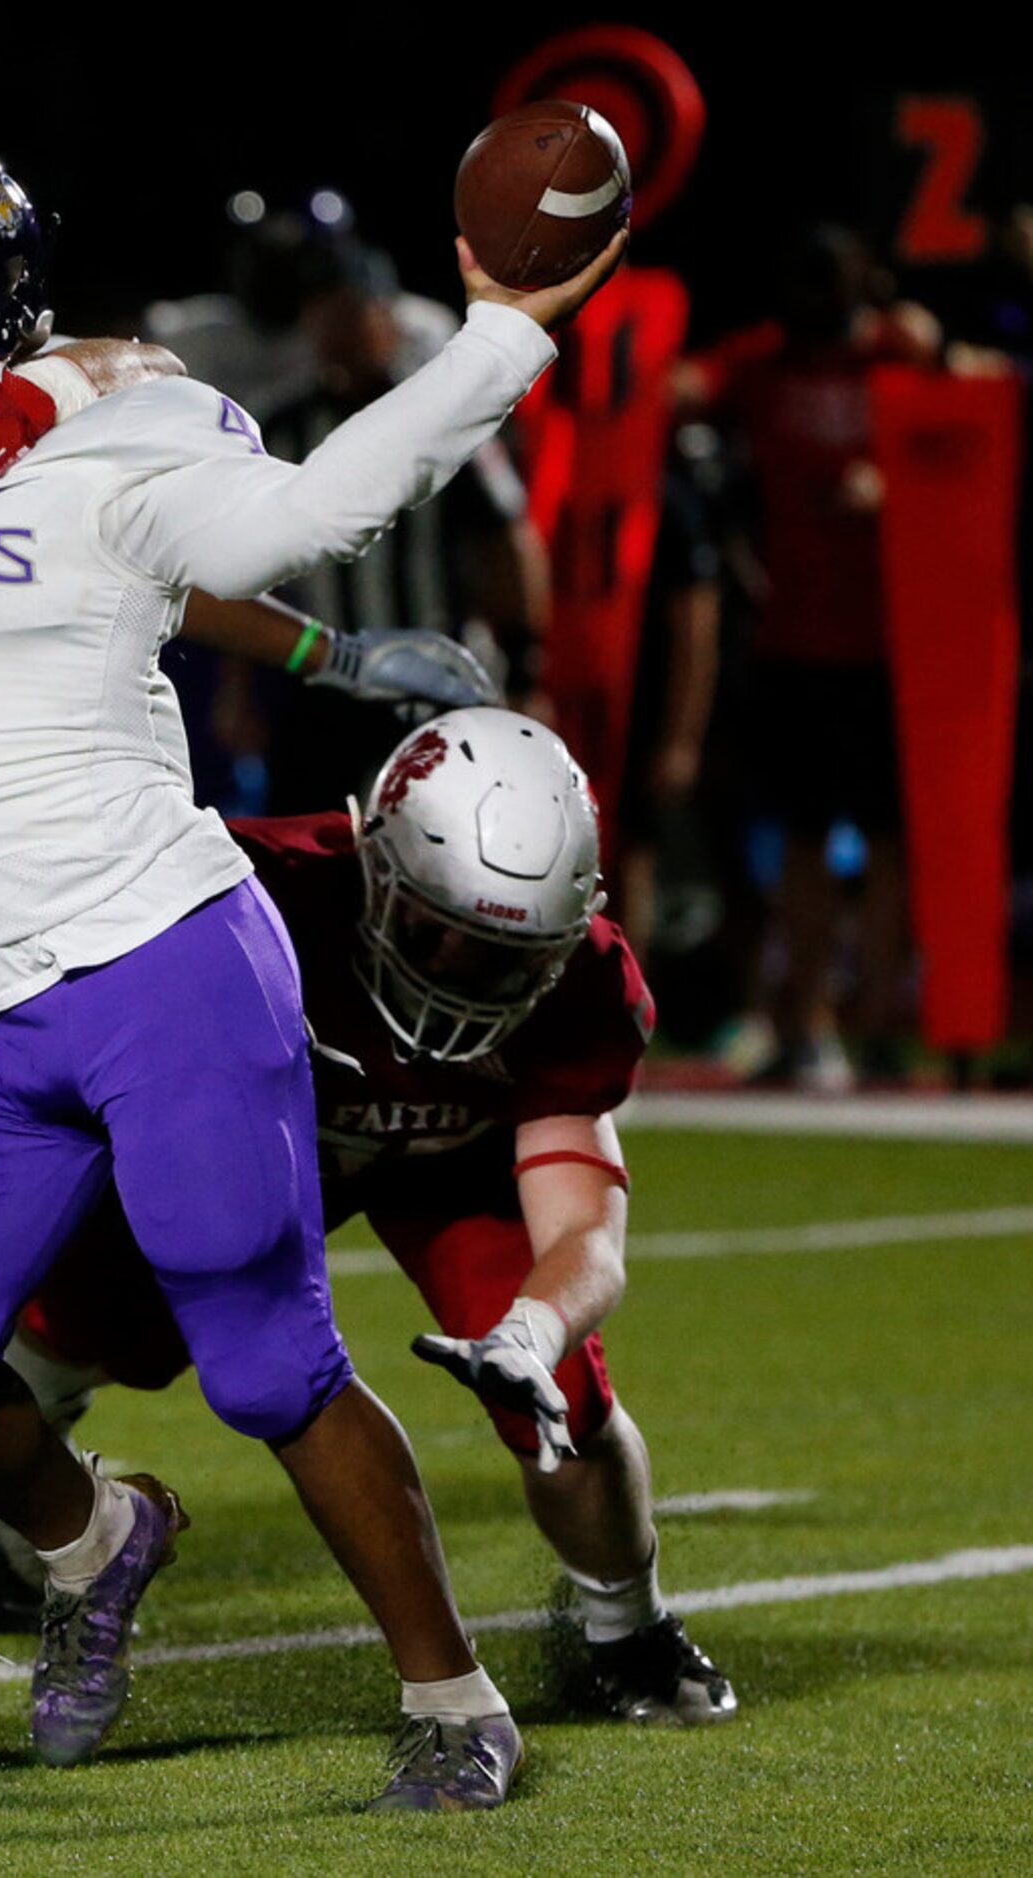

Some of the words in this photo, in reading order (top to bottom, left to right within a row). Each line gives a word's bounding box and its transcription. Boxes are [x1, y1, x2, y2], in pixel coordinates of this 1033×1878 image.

[219, 396, 265, 455] 4
[475, 898, 527, 923] LIONS
[331, 1101, 470, 1133] FAITH
